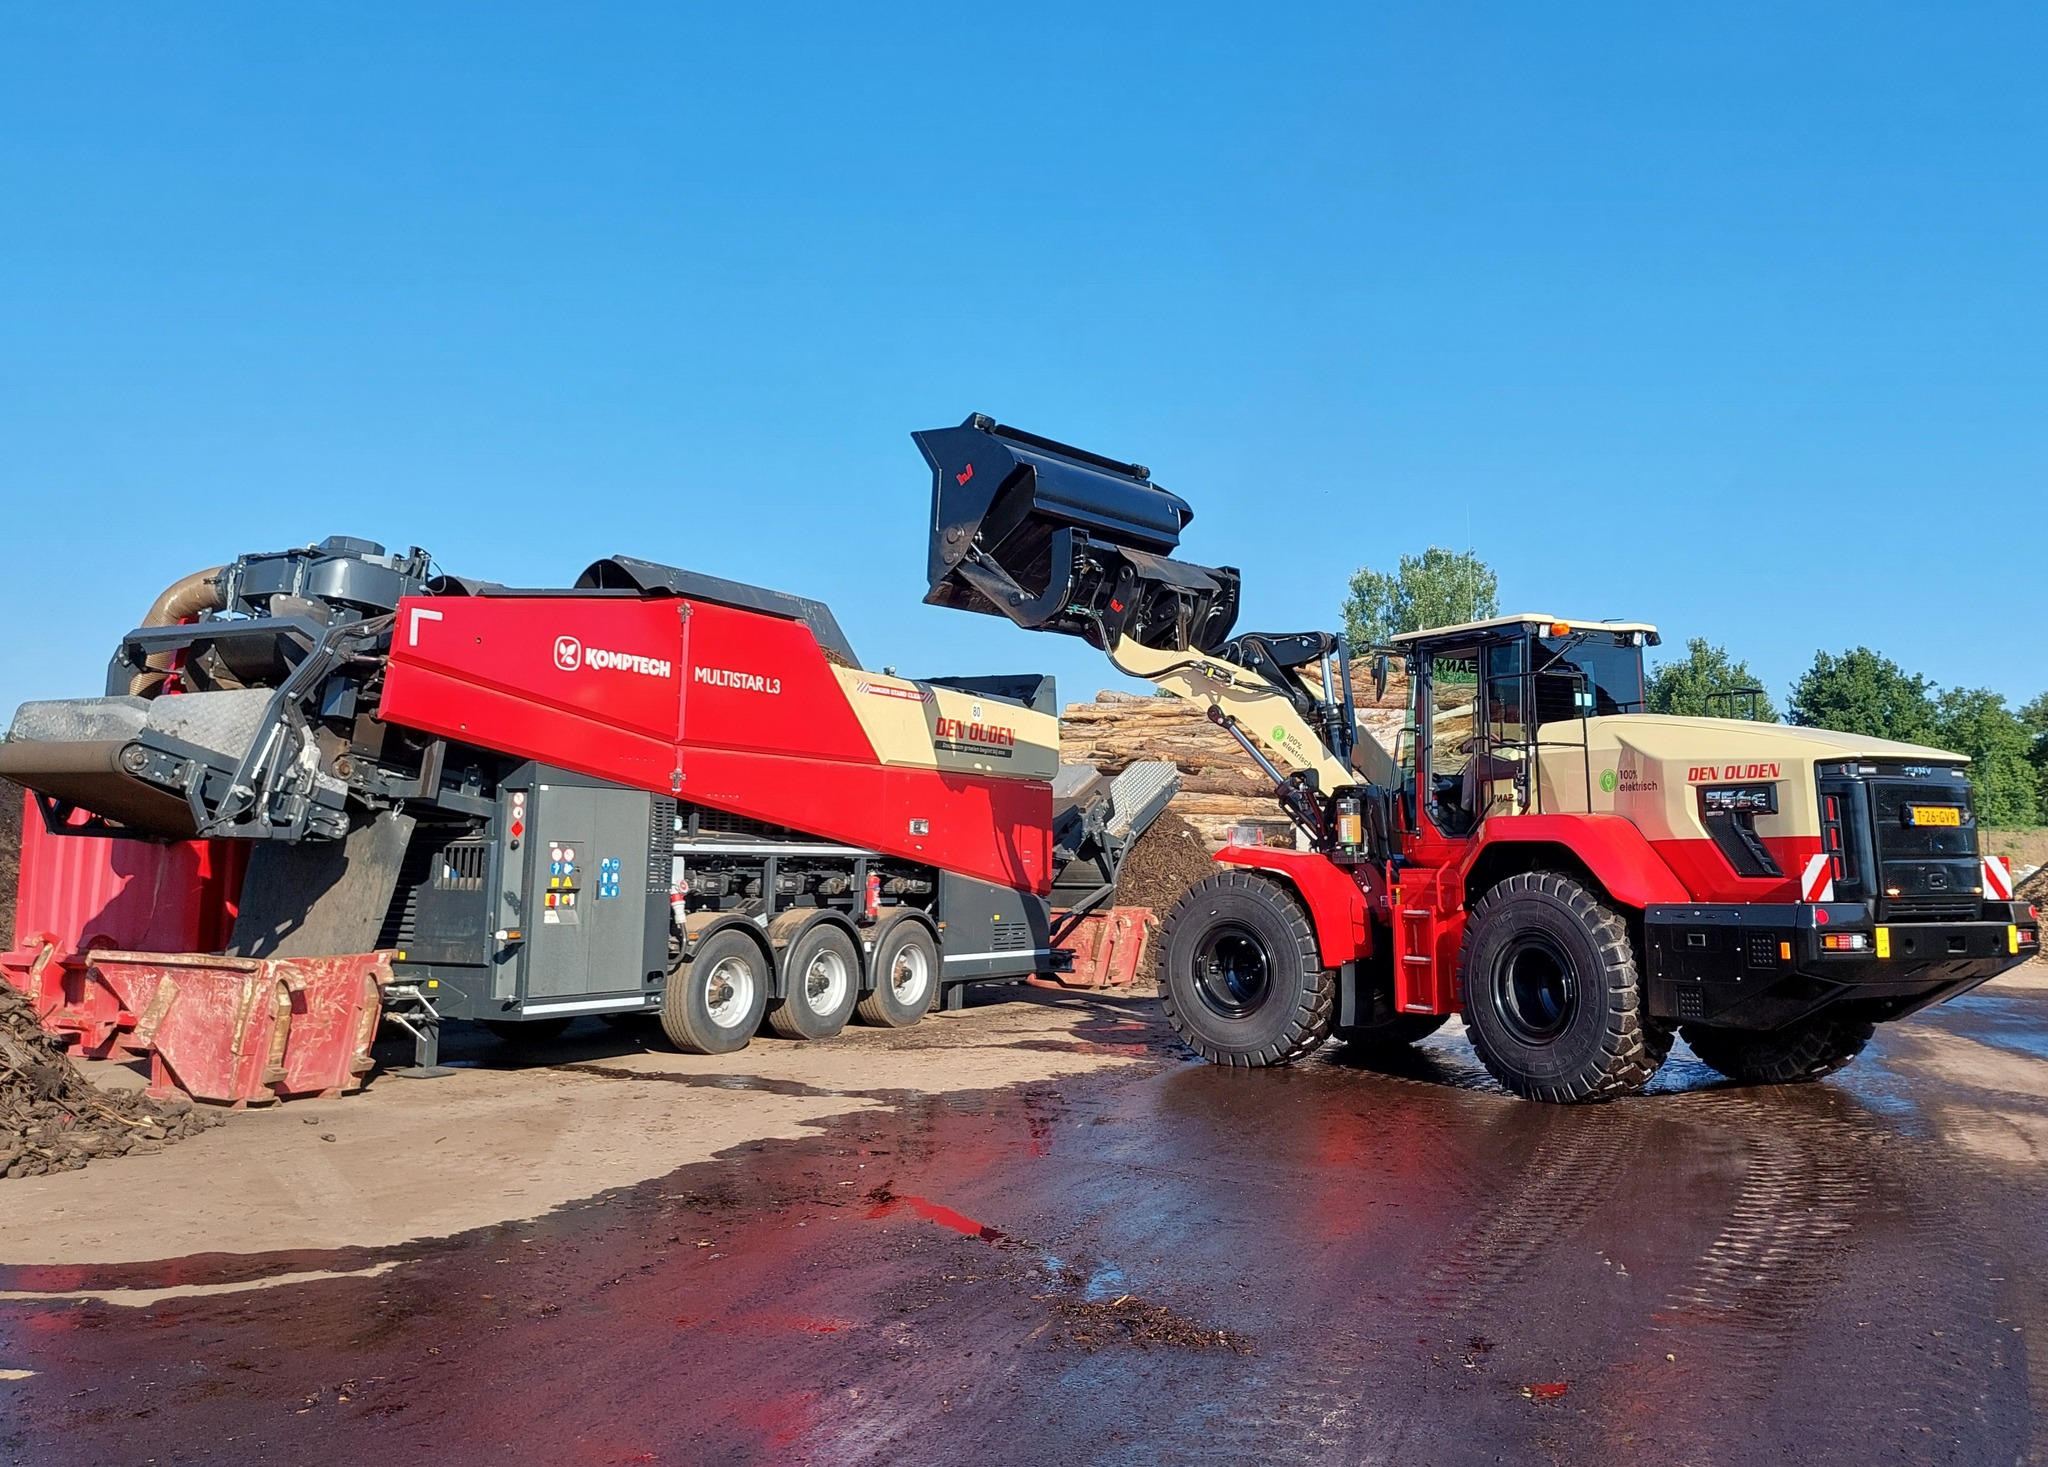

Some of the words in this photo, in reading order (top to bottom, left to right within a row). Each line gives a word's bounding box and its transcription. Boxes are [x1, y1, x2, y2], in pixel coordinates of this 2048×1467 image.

[585, 648, 671, 678] KOMPTECH
[695, 666, 764, 692] MULTISTAR
[766, 678, 781, 694] L3
[973, 706, 981, 717] 80
[935, 717, 966, 739] DEN
[969, 722, 1016, 746] OUDEN
[1286, 733, 1302, 750] 100%
[1282, 742, 1312, 768] elektrisch
[1619, 769, 1638, 780] 100%
[1688, 766, 1719, 781] DEN
[1724, 763, 1780, 780] OUDEN
[1619, 780, 1658, 792] elektrisch
[1916, 810, 1957, 824] T-26-GVR
